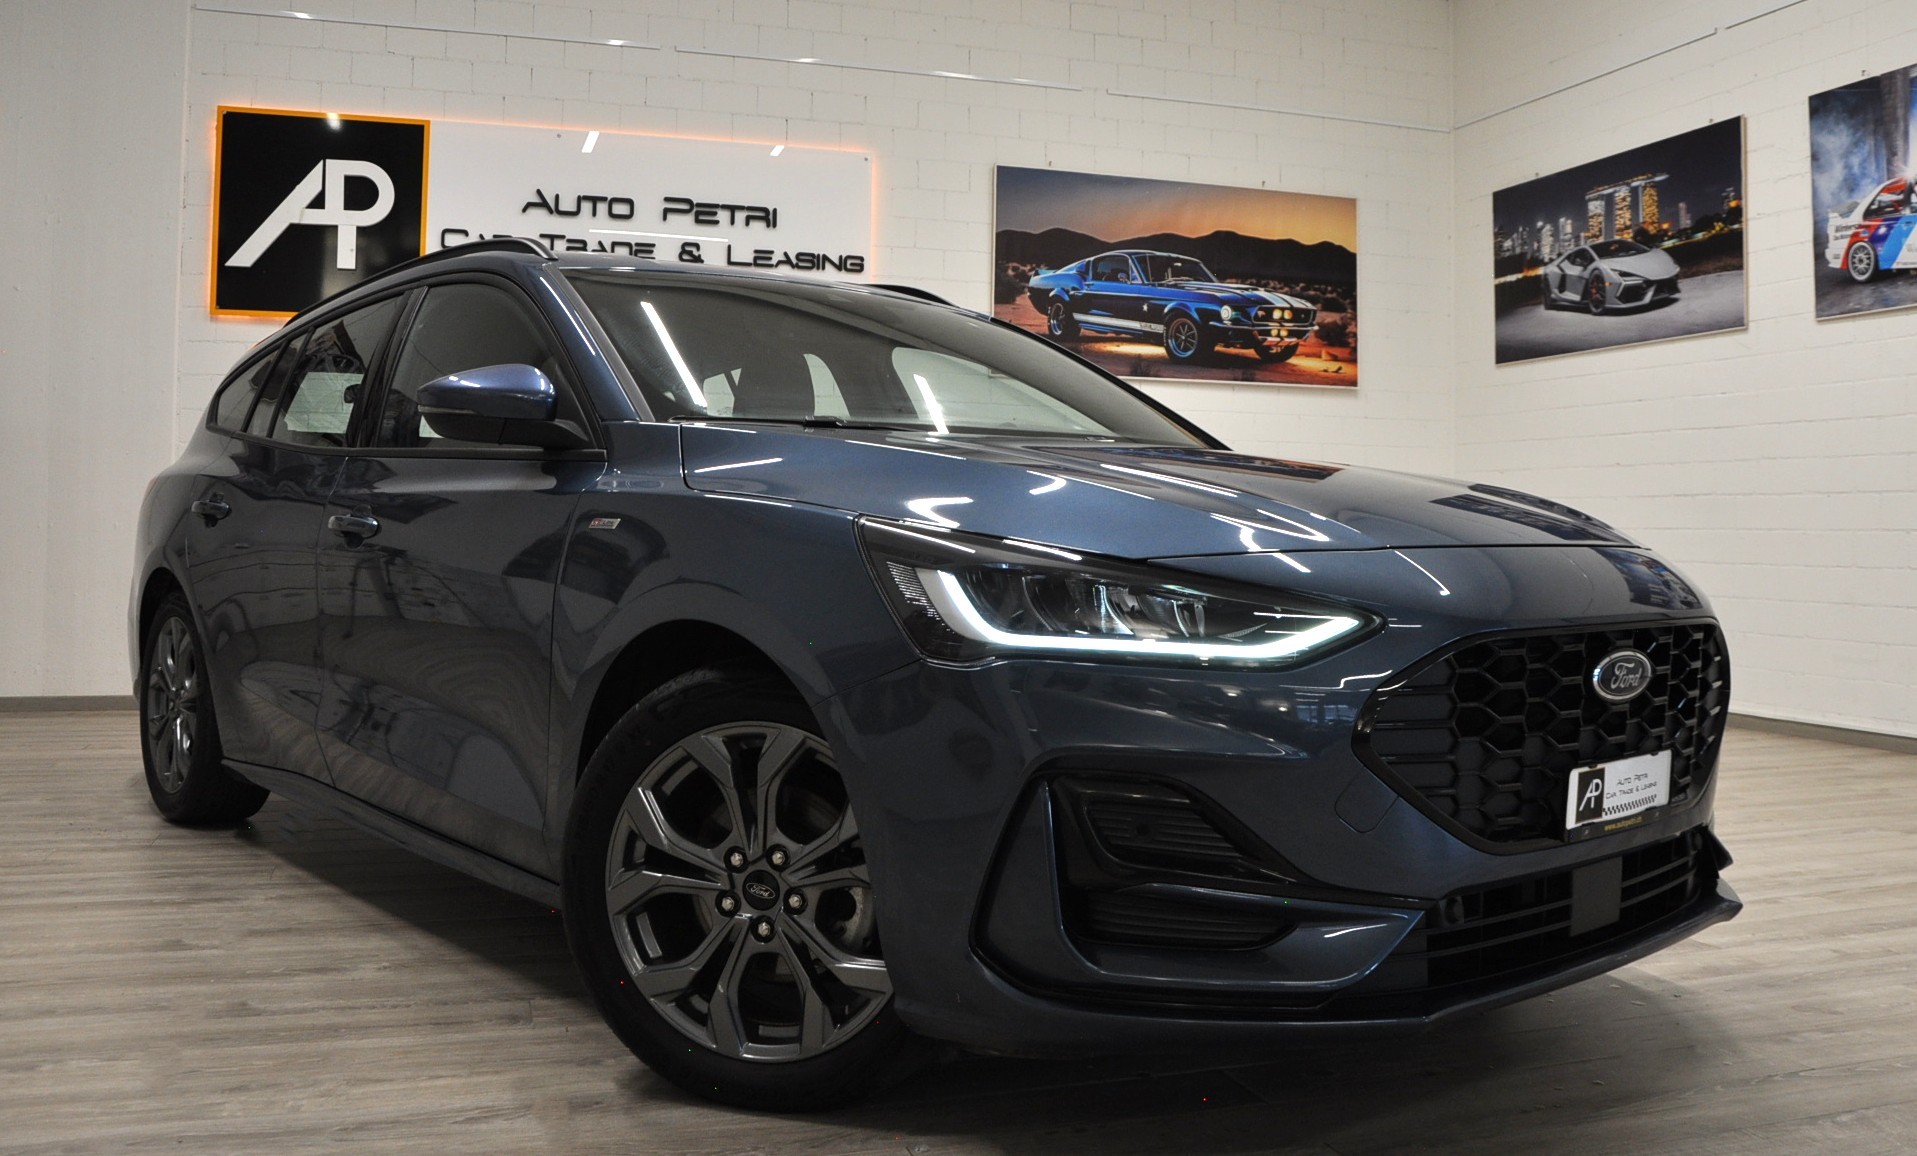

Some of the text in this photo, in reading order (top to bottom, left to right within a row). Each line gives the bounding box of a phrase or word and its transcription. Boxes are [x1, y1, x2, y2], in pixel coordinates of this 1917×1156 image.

[521, 188, 778, 228] AUTO PETRI
[678, 241, 705, 264] &
[727, 243, 865, 273] LEASING
[1610, 662, 1642, 689] Ford
[750, 884, 770, 897] Ford
